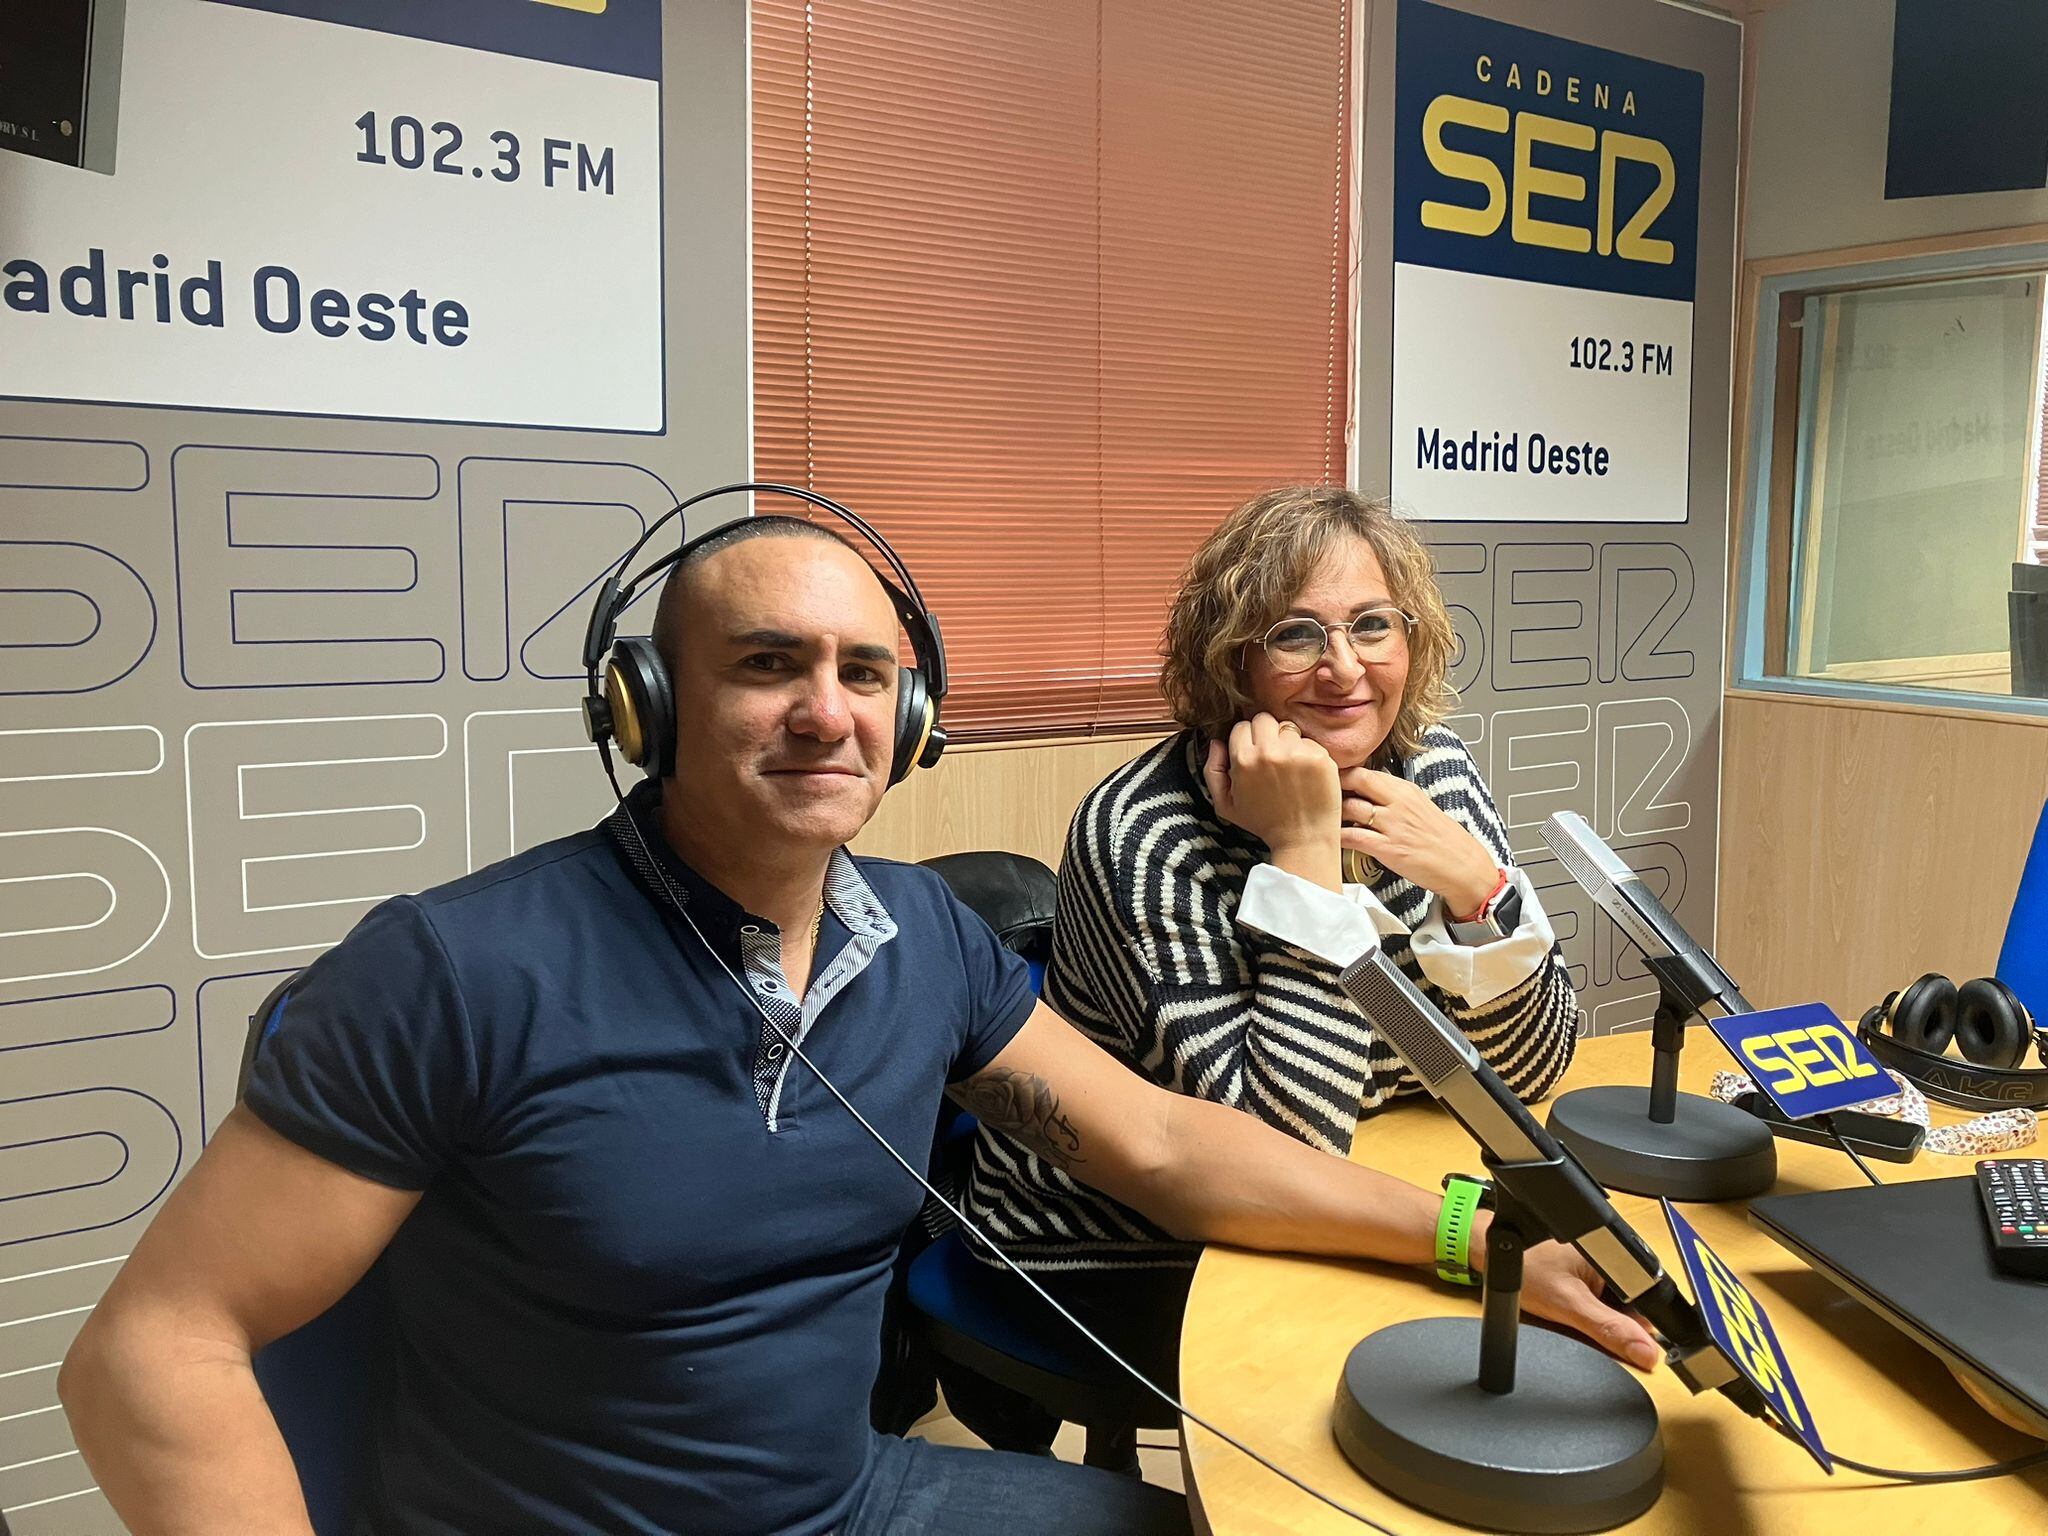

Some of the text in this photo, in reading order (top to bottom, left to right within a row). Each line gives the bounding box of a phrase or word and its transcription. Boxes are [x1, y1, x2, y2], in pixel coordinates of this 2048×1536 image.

[1475, 54, 1636, 117] CADENA
[354, 110, 616, 196] 102.3 FM
[1420, 93, 1676, 266] SER
[1, 248, 470, 348] adrid Oeste
[1569, 336, 1673, 377] 102.3 FM
[1416, 427, 1610, 477] Madrid Oeste
[1740, 1023, 1879, 1096] SER
[1920, 1065, 2035, 1103] AKG
[1693, 1238, 1805, 1432] SER
